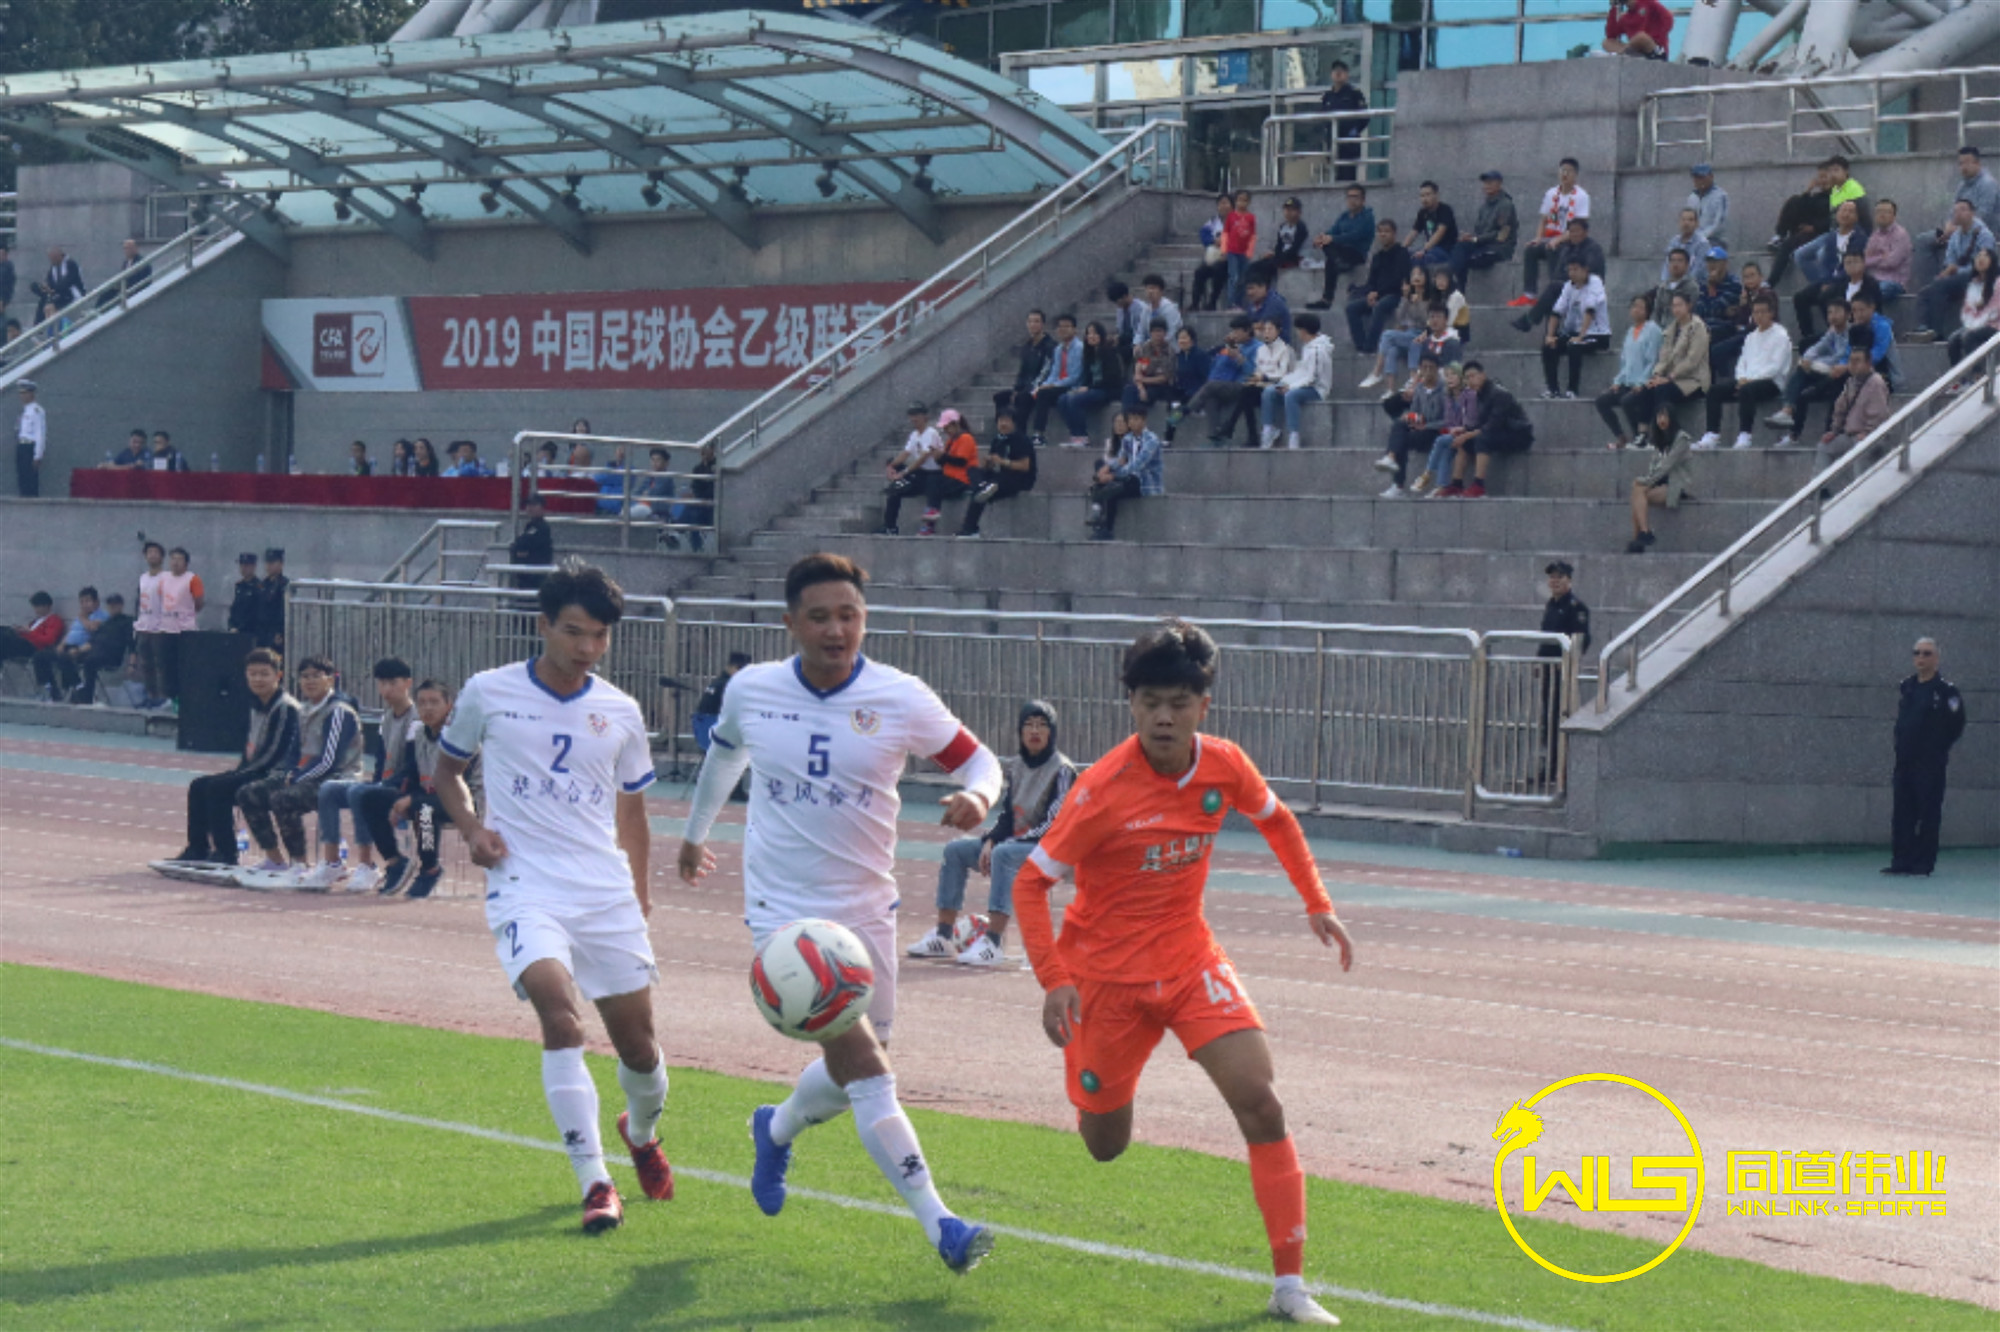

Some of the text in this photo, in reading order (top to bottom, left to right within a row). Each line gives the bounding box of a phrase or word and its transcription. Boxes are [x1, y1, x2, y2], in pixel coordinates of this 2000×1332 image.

[442, 316, 521, 368] 2019
[550, 734, 572, 774] 2
[808, 734, 831, 778] 5
[504, 920, 524, 959] 2
